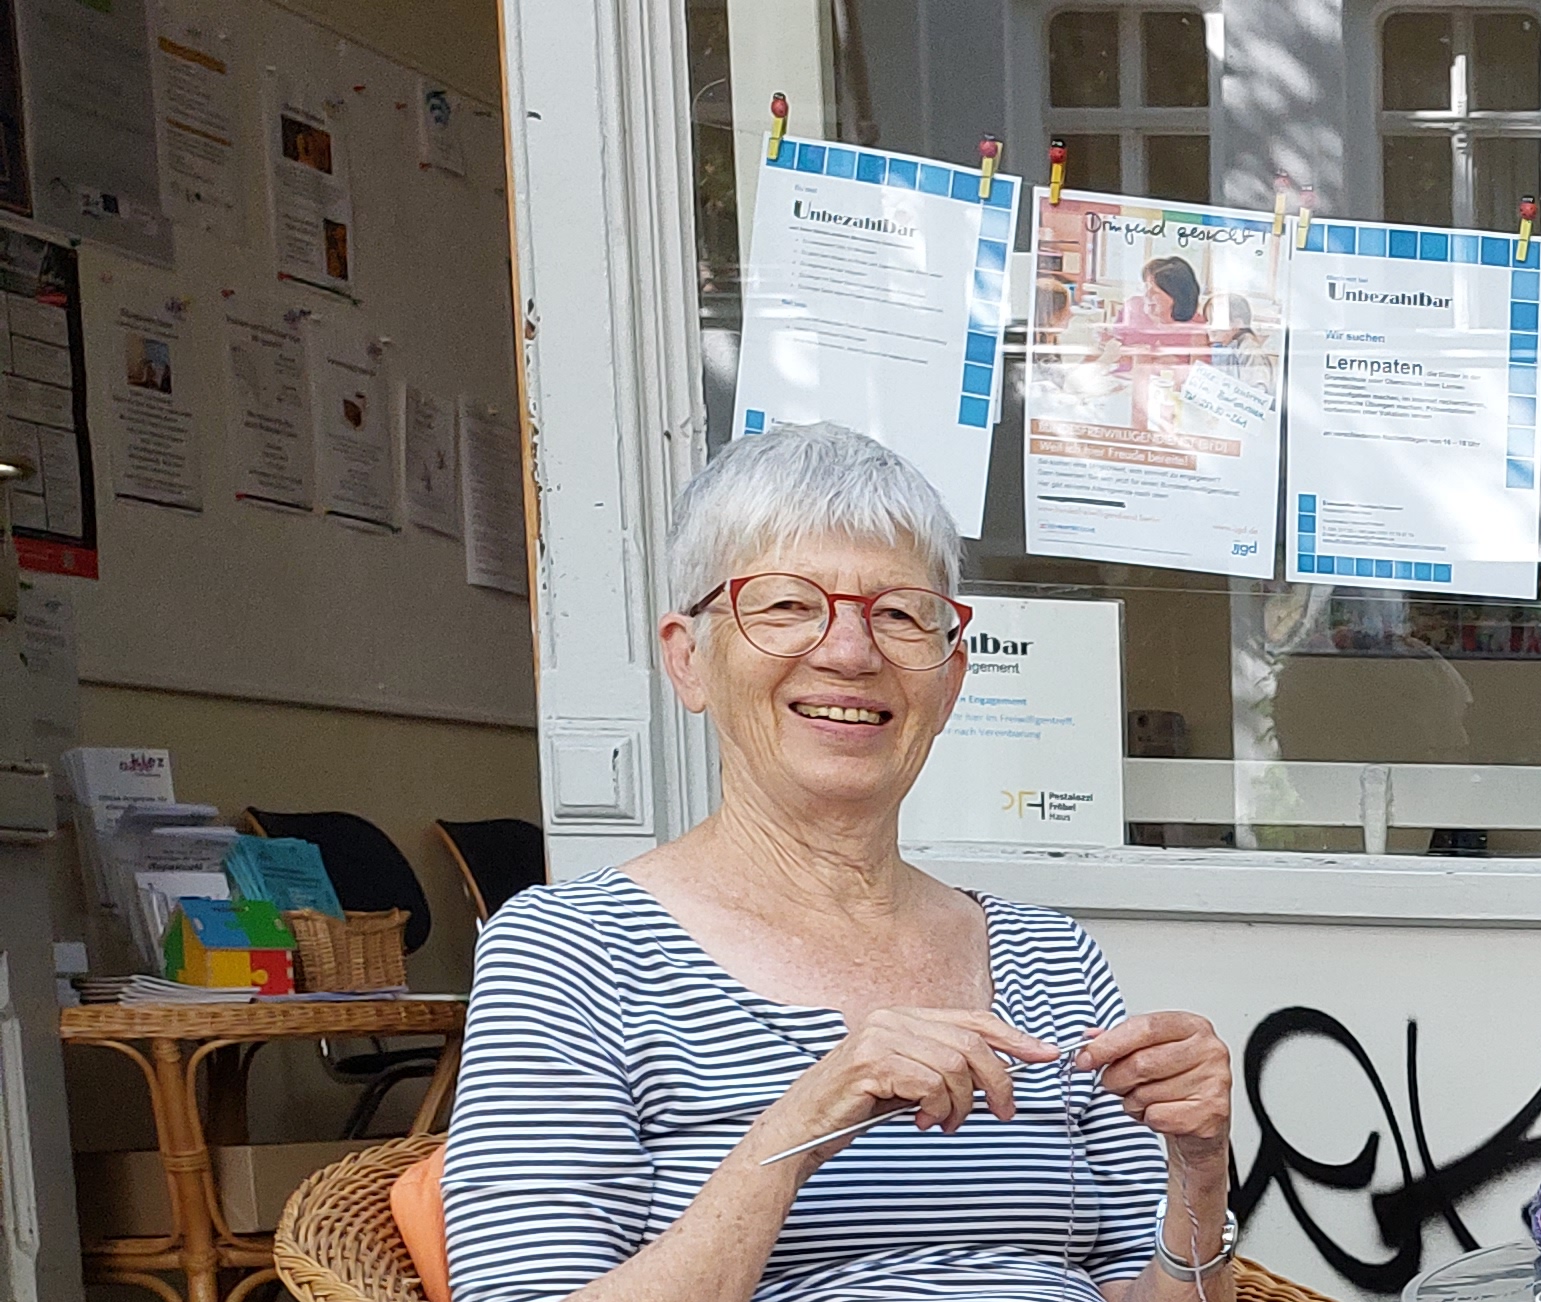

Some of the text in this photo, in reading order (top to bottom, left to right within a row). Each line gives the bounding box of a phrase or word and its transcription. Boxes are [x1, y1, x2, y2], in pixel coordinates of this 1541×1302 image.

[793, 199, 919, 237] Unbezahlbar
[1085, 211, 1166, 245] Dringend
[1328, 281, 1453, 309] Unbezahlbar
[1325, 329, 1385, 343] Wir suchen
[1325, 353, 1423, 376] Lernpaten
[1048, 791, 1093, 802] Pestalozzi
[1048, 802, 1077, 812] Fröbel
